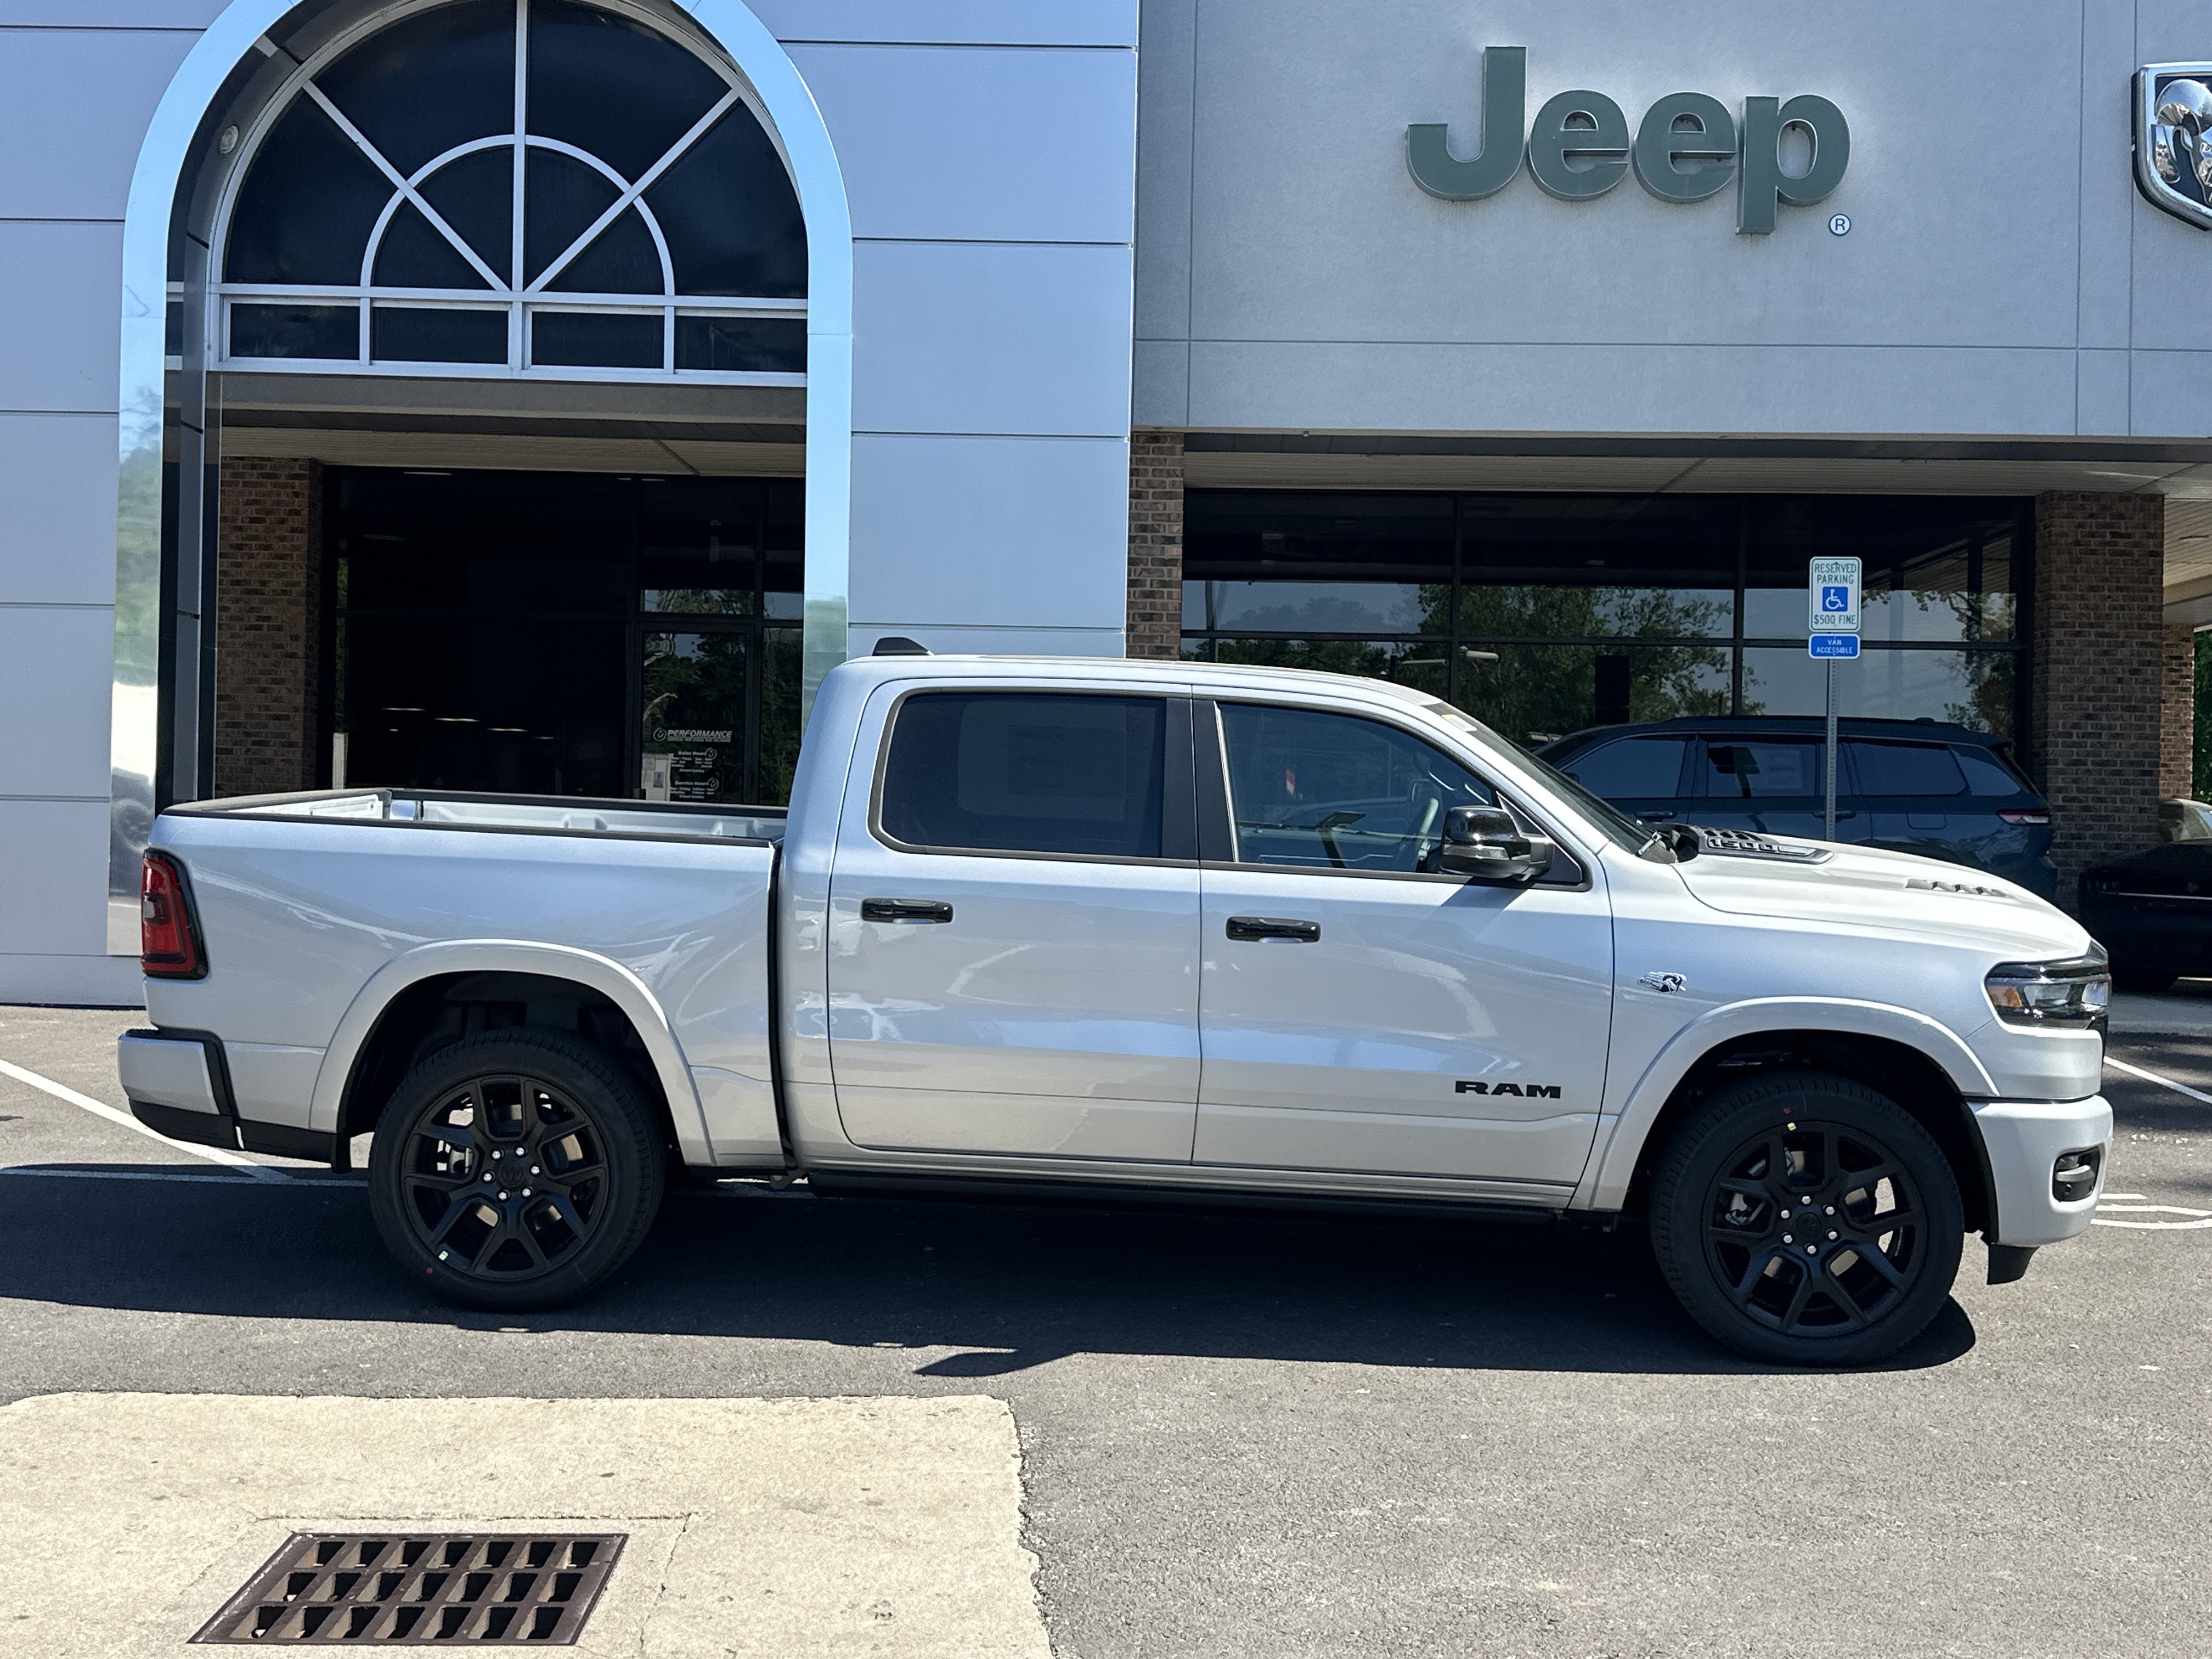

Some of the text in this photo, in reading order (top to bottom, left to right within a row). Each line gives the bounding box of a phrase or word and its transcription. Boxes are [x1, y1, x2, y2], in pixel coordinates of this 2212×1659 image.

[1406, 46, 1851, 234] Jeep
[1814, 563, 1857, 573] RESERVED
[1817, 574, 1854, 584] PARKING
[1814, 614, 1856, 624] $500 FINE
[667, 729, 733, 737] PERFORMANCE
[1708, 837, 1778, 853] 1500
[1455, 1080, 1561, 1099] RAM
